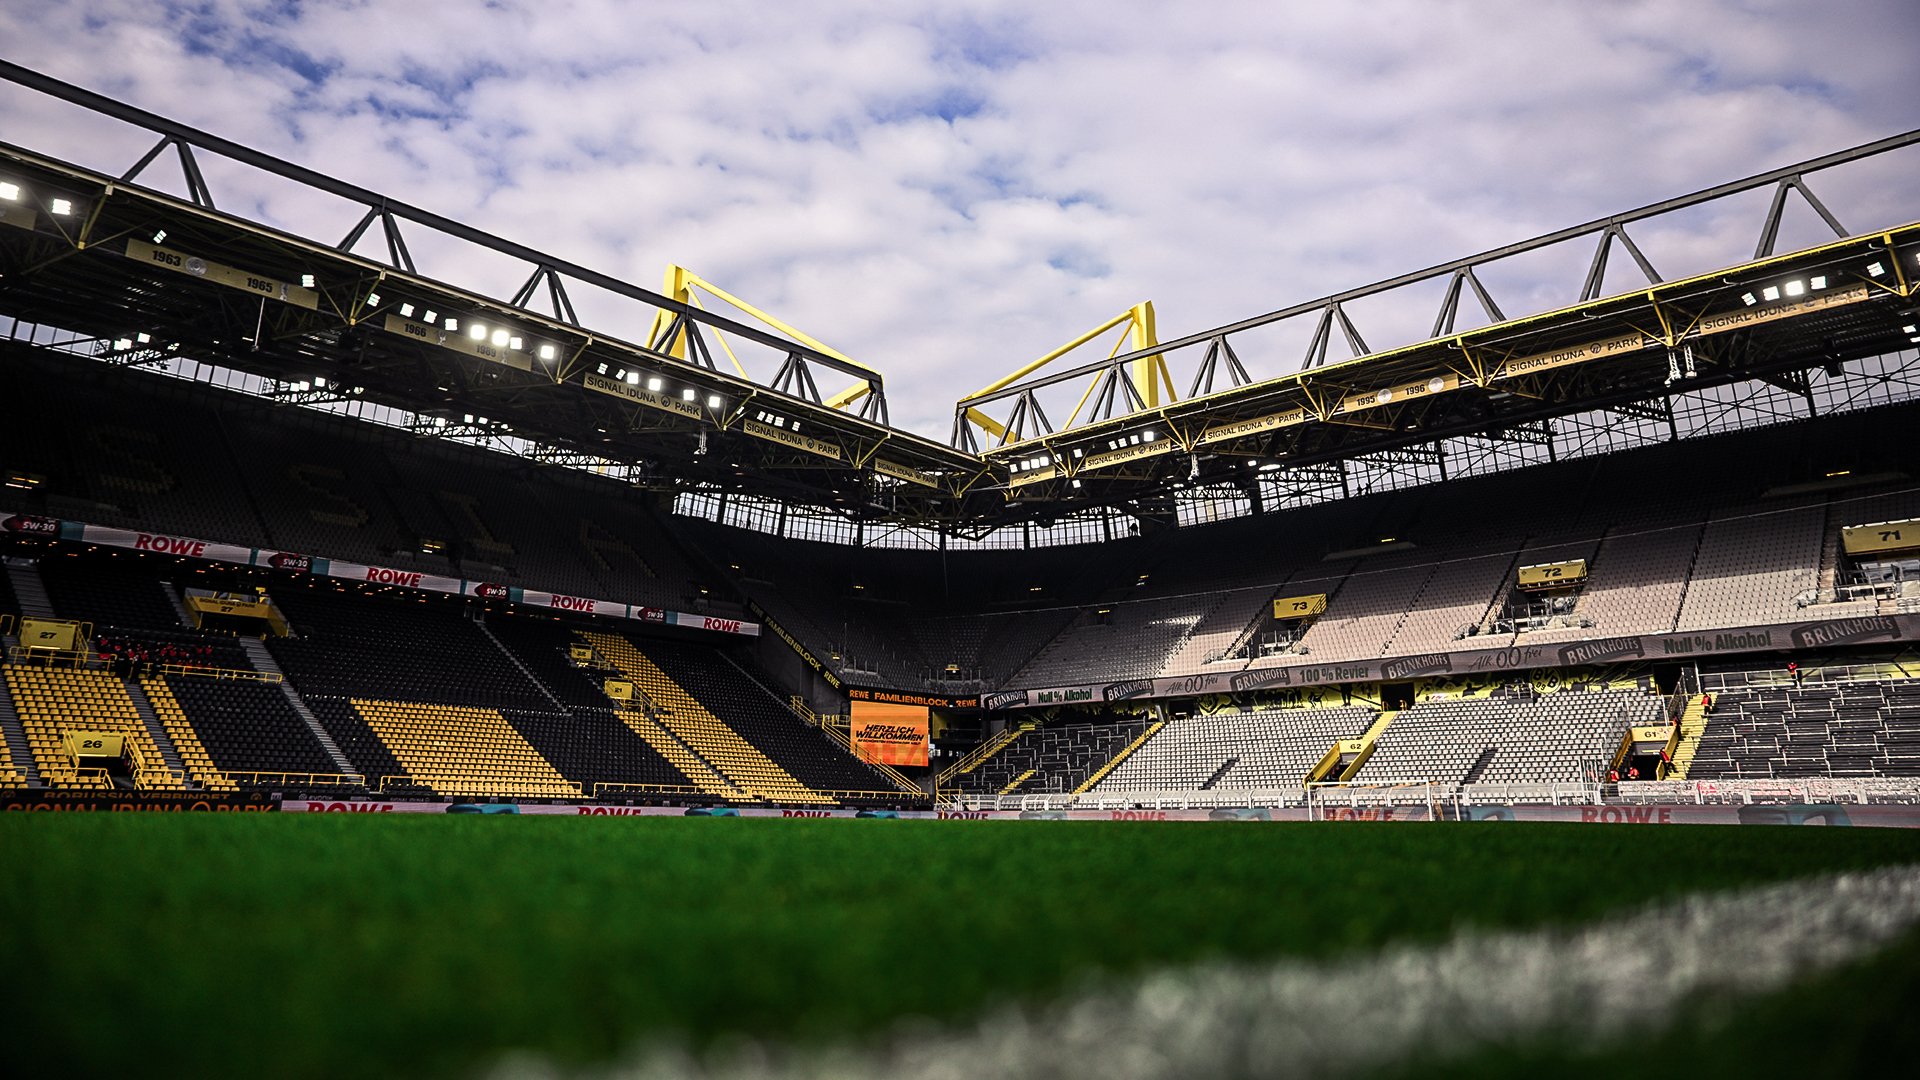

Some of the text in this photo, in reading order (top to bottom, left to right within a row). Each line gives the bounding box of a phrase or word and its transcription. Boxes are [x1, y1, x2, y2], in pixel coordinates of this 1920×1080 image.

[152, 250, 182, 267] 1963
[246, 277, 273, 293] 1965
[1704, 287, 1864, 330] SIGNAL IDUNA PARK
[404, 323, 427, 338] 1966
[475, 344, 497, 358] 1989
[1509, 336, 1639, 372] SIGNAL IDUNA PARK
[586, 376, 700, 416] SIGNAL IDUNA PARK
[1405, 384, 1425, 396] 1996
[1356, 395, 1376, 406] 1995
[1207, 411, 1301, 439] SIGNAL IDUNA PARK
[746, 422, 839, 457] SIGNAL IDUNA PARK
[1088, 442, 1169, 467] SIGNAL IDUNA PARK
[1878, 530, 1901, 541] 71
[135, 533, 206, 557] ROWE
[366, 567, 421, 587] ROWE
[1542, 567, 1562, 578] 72
[551, 594, 595, 613] ROWE
[1292, 601, 1308, 611] 73
[703, 617, 740, 633] ROWE
[39, 631, 57, 639] 27
[1662, 630, 1772, 654] Null % Alkohol
[764, 617, 821, 672] FAMILIENBLOCK
[823, 670, 840, 689] REWE
[1523, 647, 1543, 664] frei
[1299, 666, 1369, 683] 100 % Revier
[1533, 668, 1558, 688] BVB
[1536, 681, 1546, 690] 09
[849, 689, 977, 707] REWE FAMILIENBLOCK REWE
[1038, 688, 1092, 704] Null % Alkohol
[856, 730, 924, 742] WILLKOMMEN
[865, 724, 915, 734] HERZLICH
[83, 740, 103, 748] 26
[1580, 807, 1671, 823] ROWE
